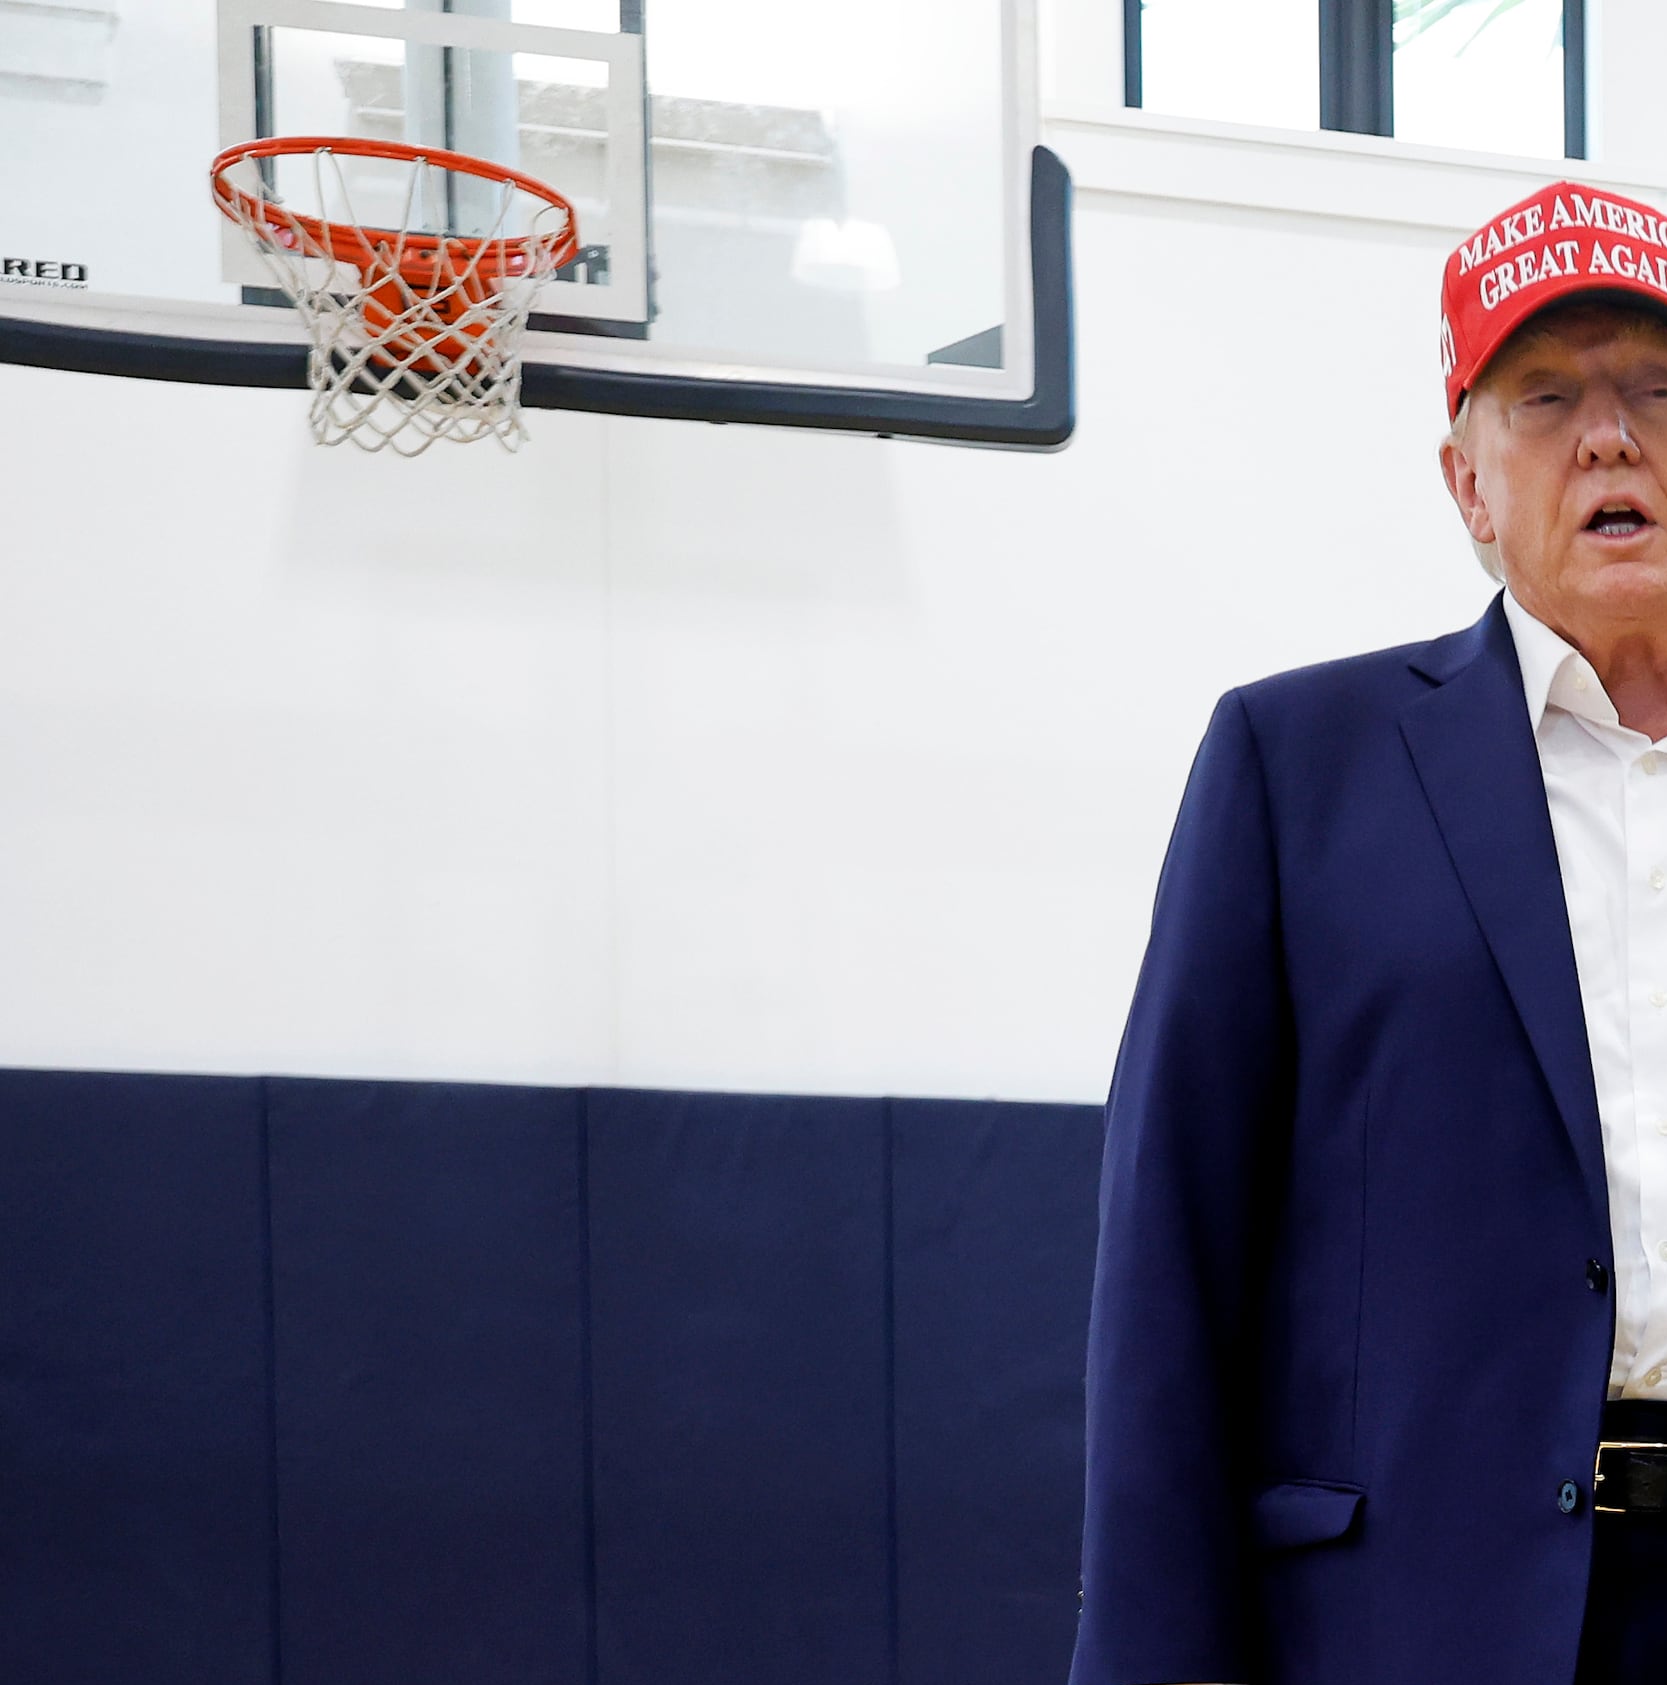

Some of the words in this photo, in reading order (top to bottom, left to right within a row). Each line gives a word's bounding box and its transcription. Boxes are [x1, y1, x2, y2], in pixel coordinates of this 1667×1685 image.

[0, 258, 88, 281] RED
[1458, 204, 1545, 276] MAKE
[1480, 241, 1580, 311] GREAT
